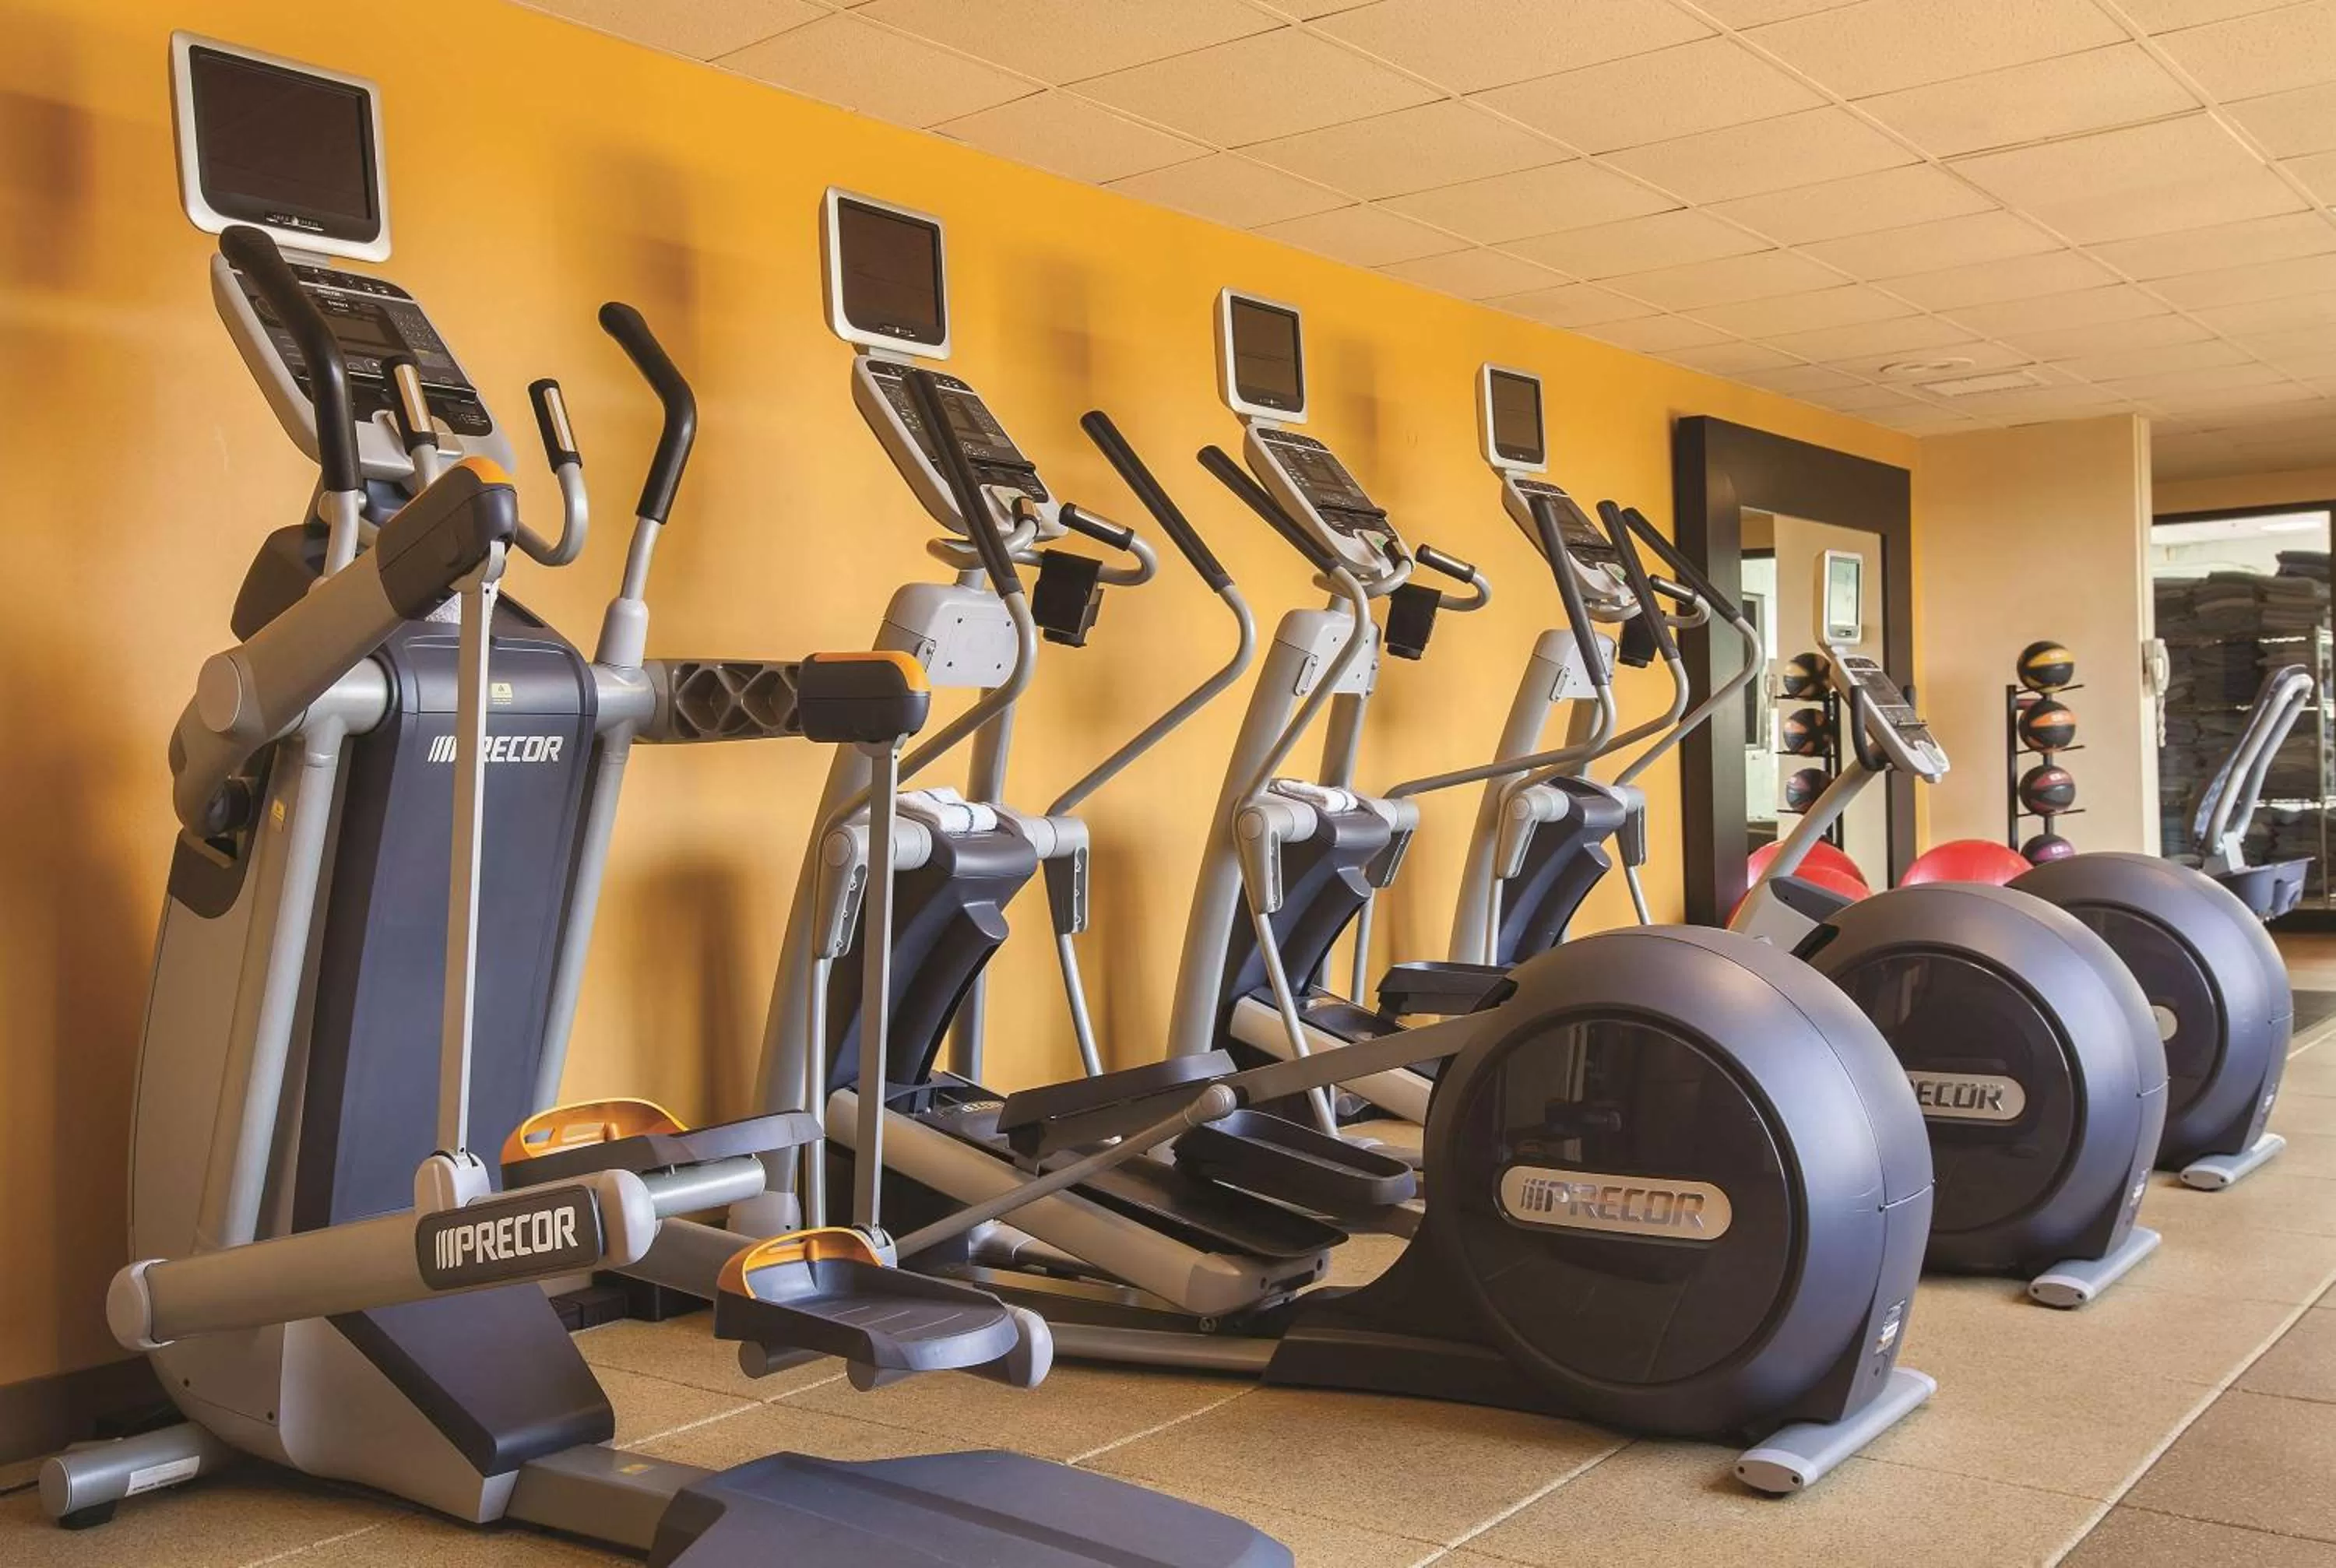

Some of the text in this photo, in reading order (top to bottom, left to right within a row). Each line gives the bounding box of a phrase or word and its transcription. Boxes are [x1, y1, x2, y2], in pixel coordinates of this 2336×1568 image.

[1909, 1078, 2004, 1111] ECOR
[1543, 1180, 1705, 1230] PRECOR
[455, 1206, 579, 1267] PRECOR
